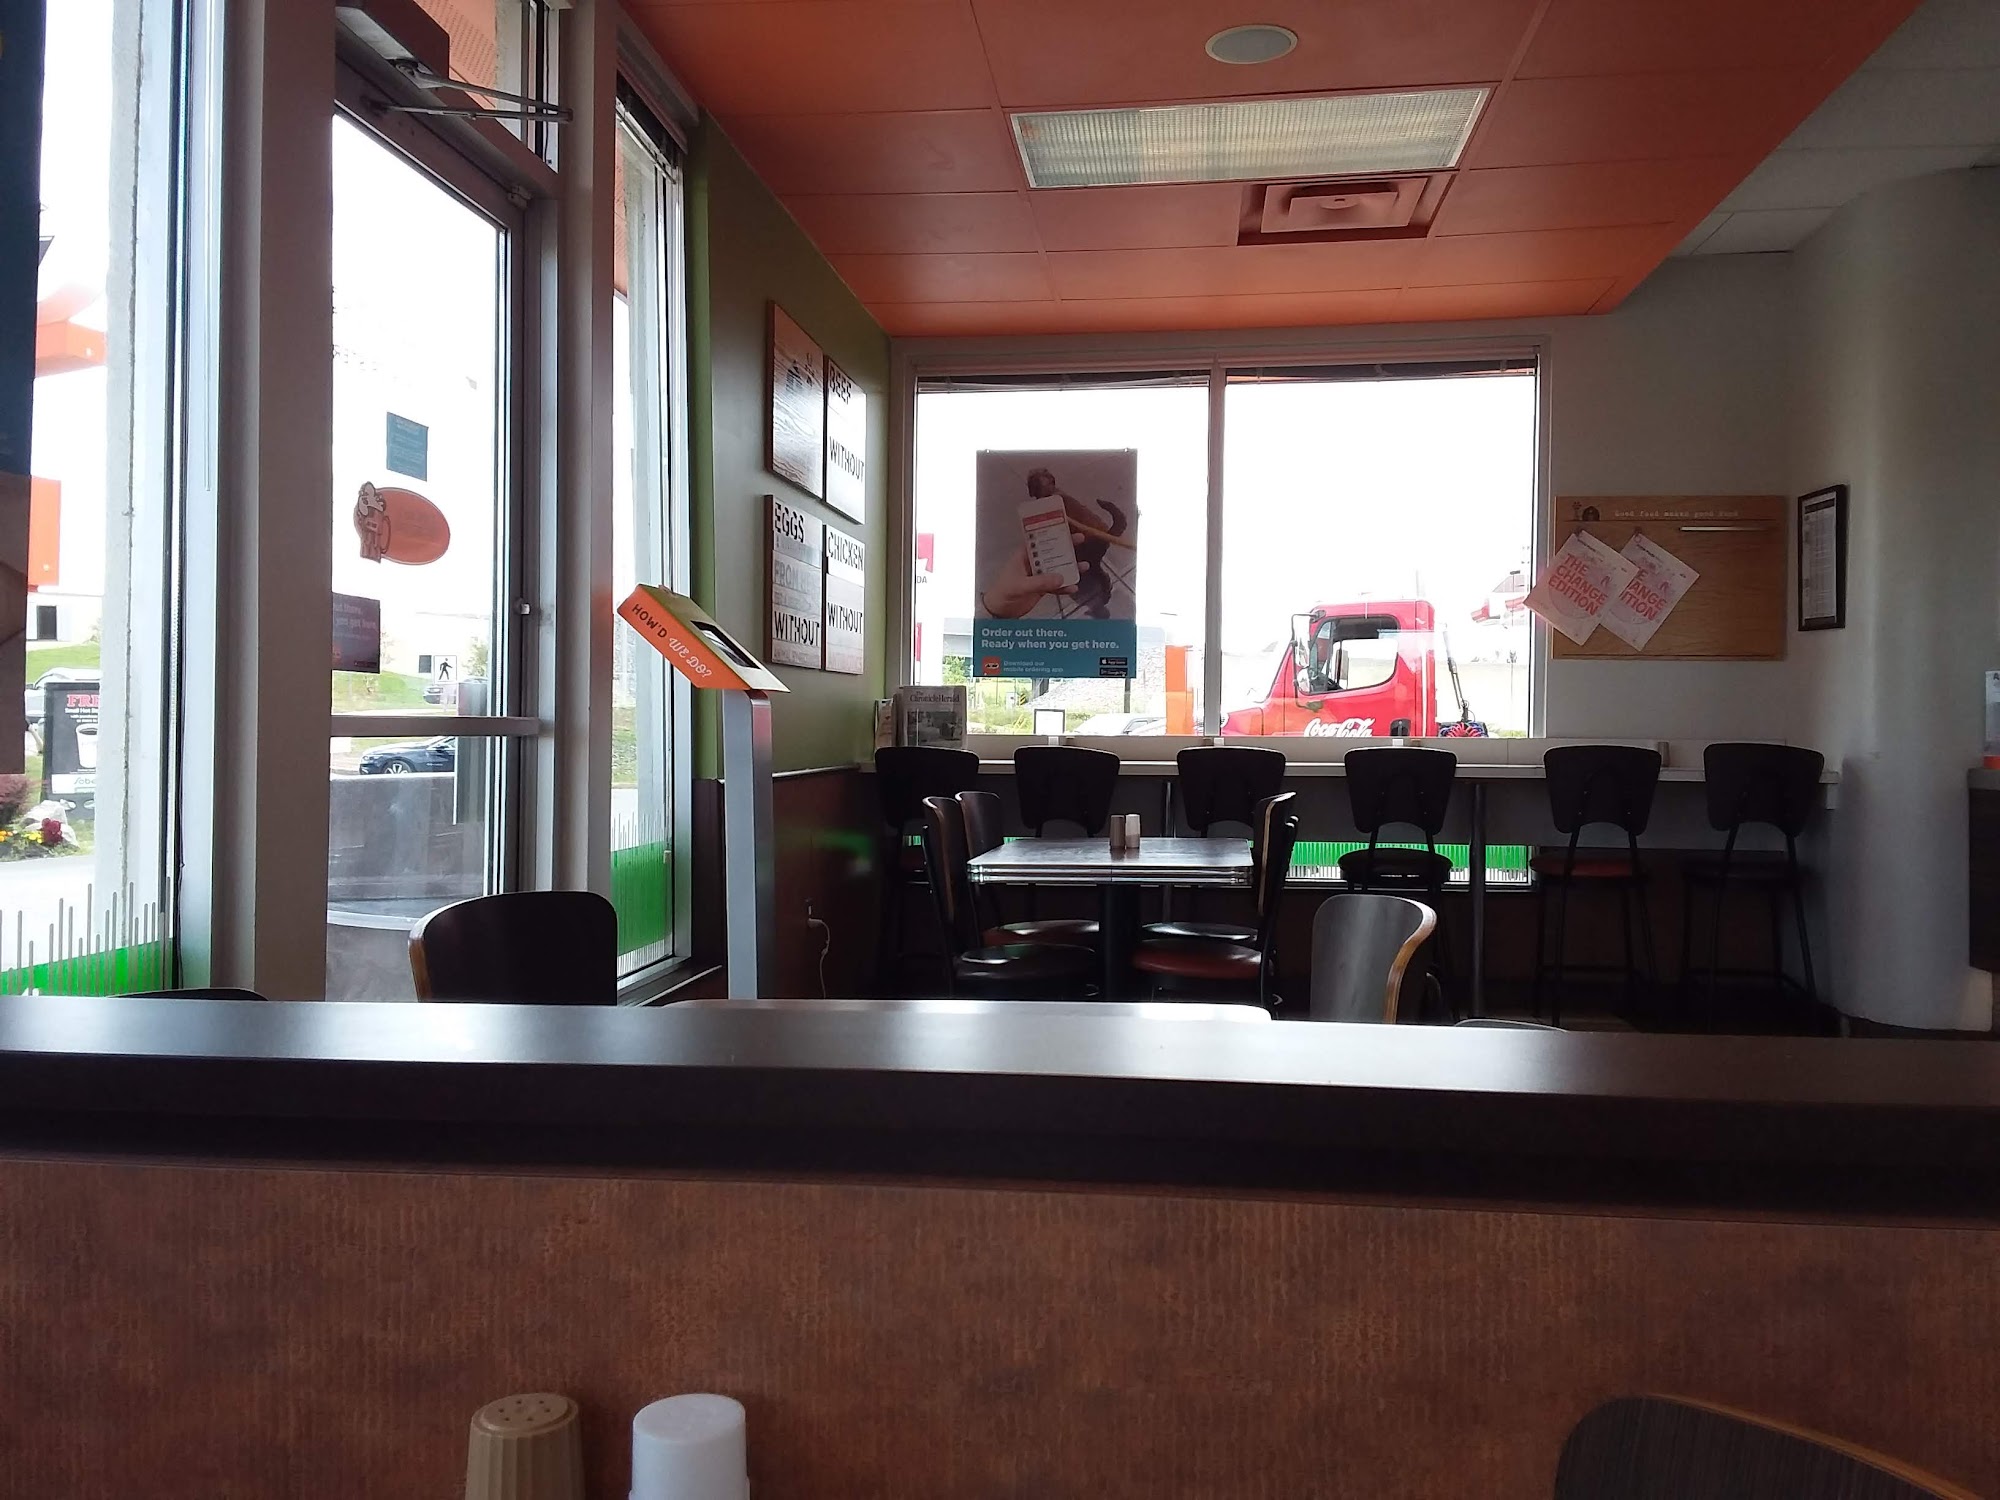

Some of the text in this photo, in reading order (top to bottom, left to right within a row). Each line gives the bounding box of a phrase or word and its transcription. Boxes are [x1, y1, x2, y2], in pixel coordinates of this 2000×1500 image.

[829, 364, 852, 405] BEEF
[829, 436, 864, 483] WITHOUT
[774, 502, 805, 543] EGGS
[828, 532, 864, 571] CHICKEN
[1563, 553, 1589, 576] THE
[1548, 576, 1599, 616] EDITION
[1556, 565, 1609, 606] CHANGE
[1627, 581, 1668, 611] ANGE
[828, 602, 863, 635] WITHOUT
[1620, 591, 1659, 621] ITION
[632, 604, 712, 678] HOW'D WE DO?
[774, 611, 820, 647] WITHOUT
[981, 628, 1067, 637] Order out there.
[981, 639, 1119, 650] Ready when you get here.
[1303, 717, 1376, 738] Coca-Cola
